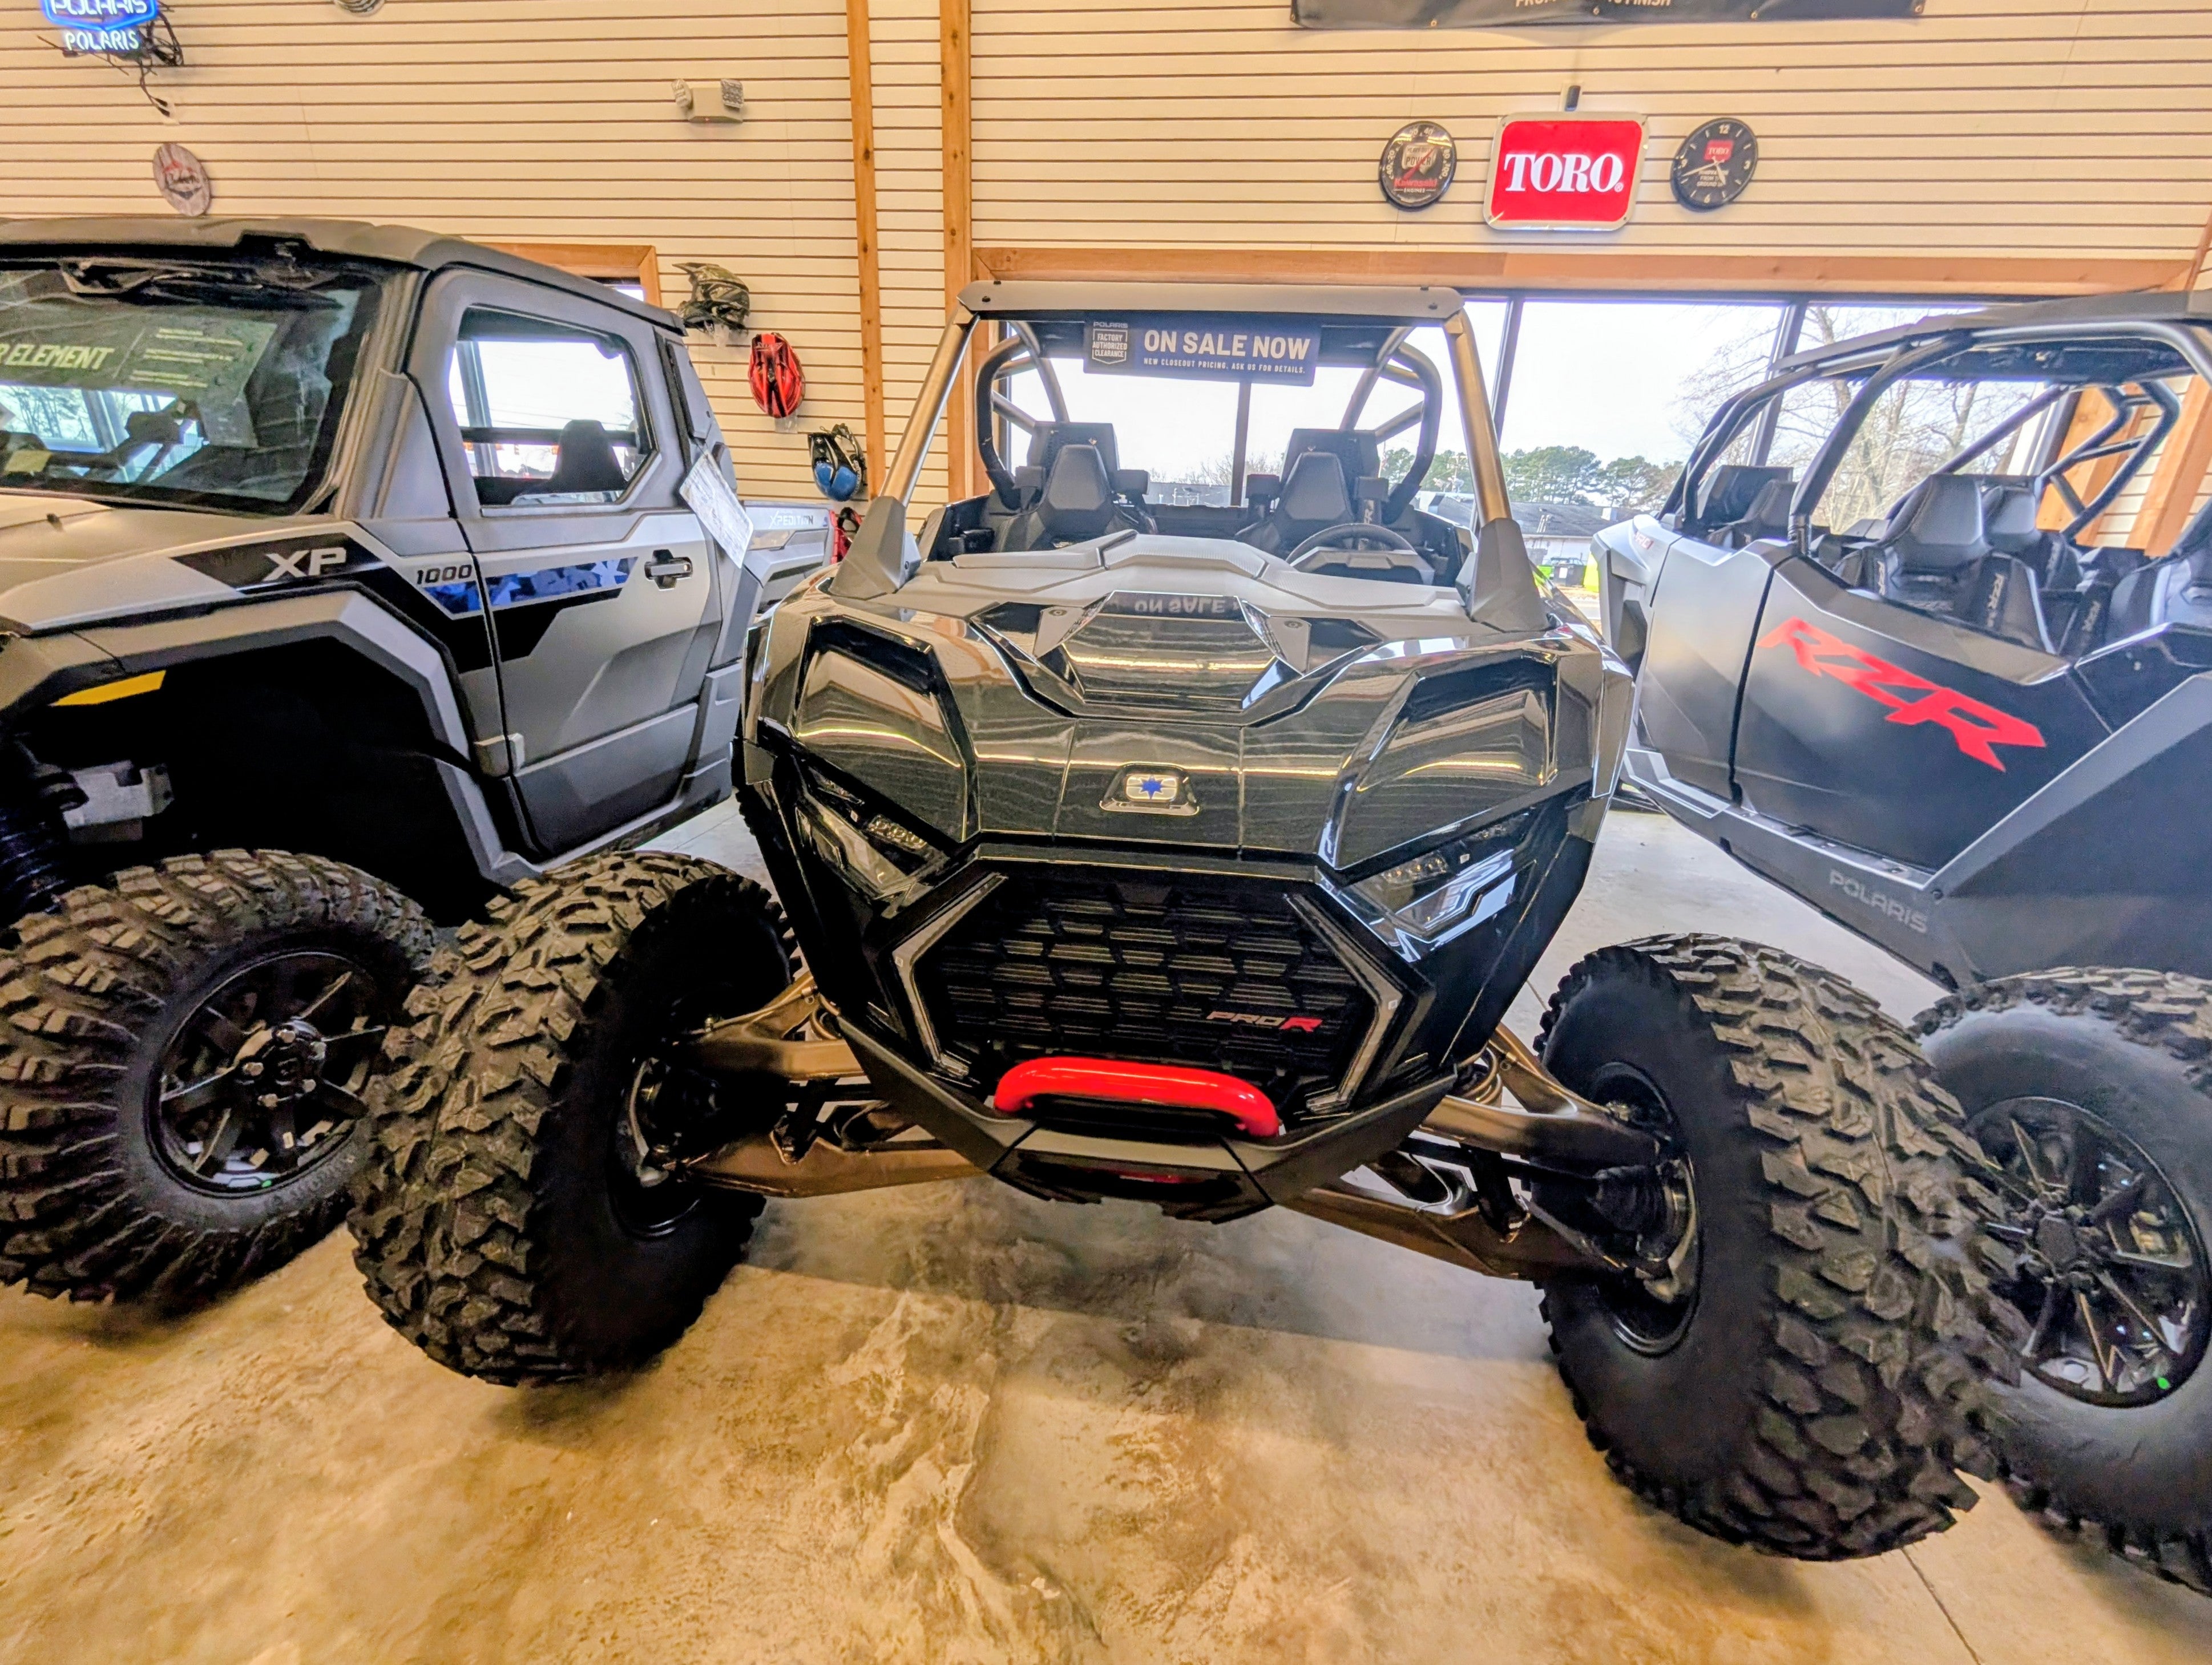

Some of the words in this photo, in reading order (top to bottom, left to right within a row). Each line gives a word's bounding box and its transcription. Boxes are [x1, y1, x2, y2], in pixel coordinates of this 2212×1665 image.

[64, 30, 139, 51] POLARIS
[1719, 124, 1730, 134] 12
[1743, 160, 1751, 169] 3
[1092, 342, 1128, 350] AUTHORIZED
[1097, 333, 1123, 342] FACTORY
[1144, 330, 1177, 353] ON
[1182, 332, 1248, 357] SALE
[1252, 336, 1310, 360] NOW
[4, 343, 115, 370] ELEMENT
[1161, 359, 1195, 367] CLOSEOUT
[1198, 361, 1228, 370] PRICING.
[263, 547, 348, 582] XP
[415, 564, 472, 585] 1000
[1756, 616, 2046, 773] RZR
[1830, 869, 1928, 934] POLARIS
[1206, 1011, 1285, 1027] PRO
